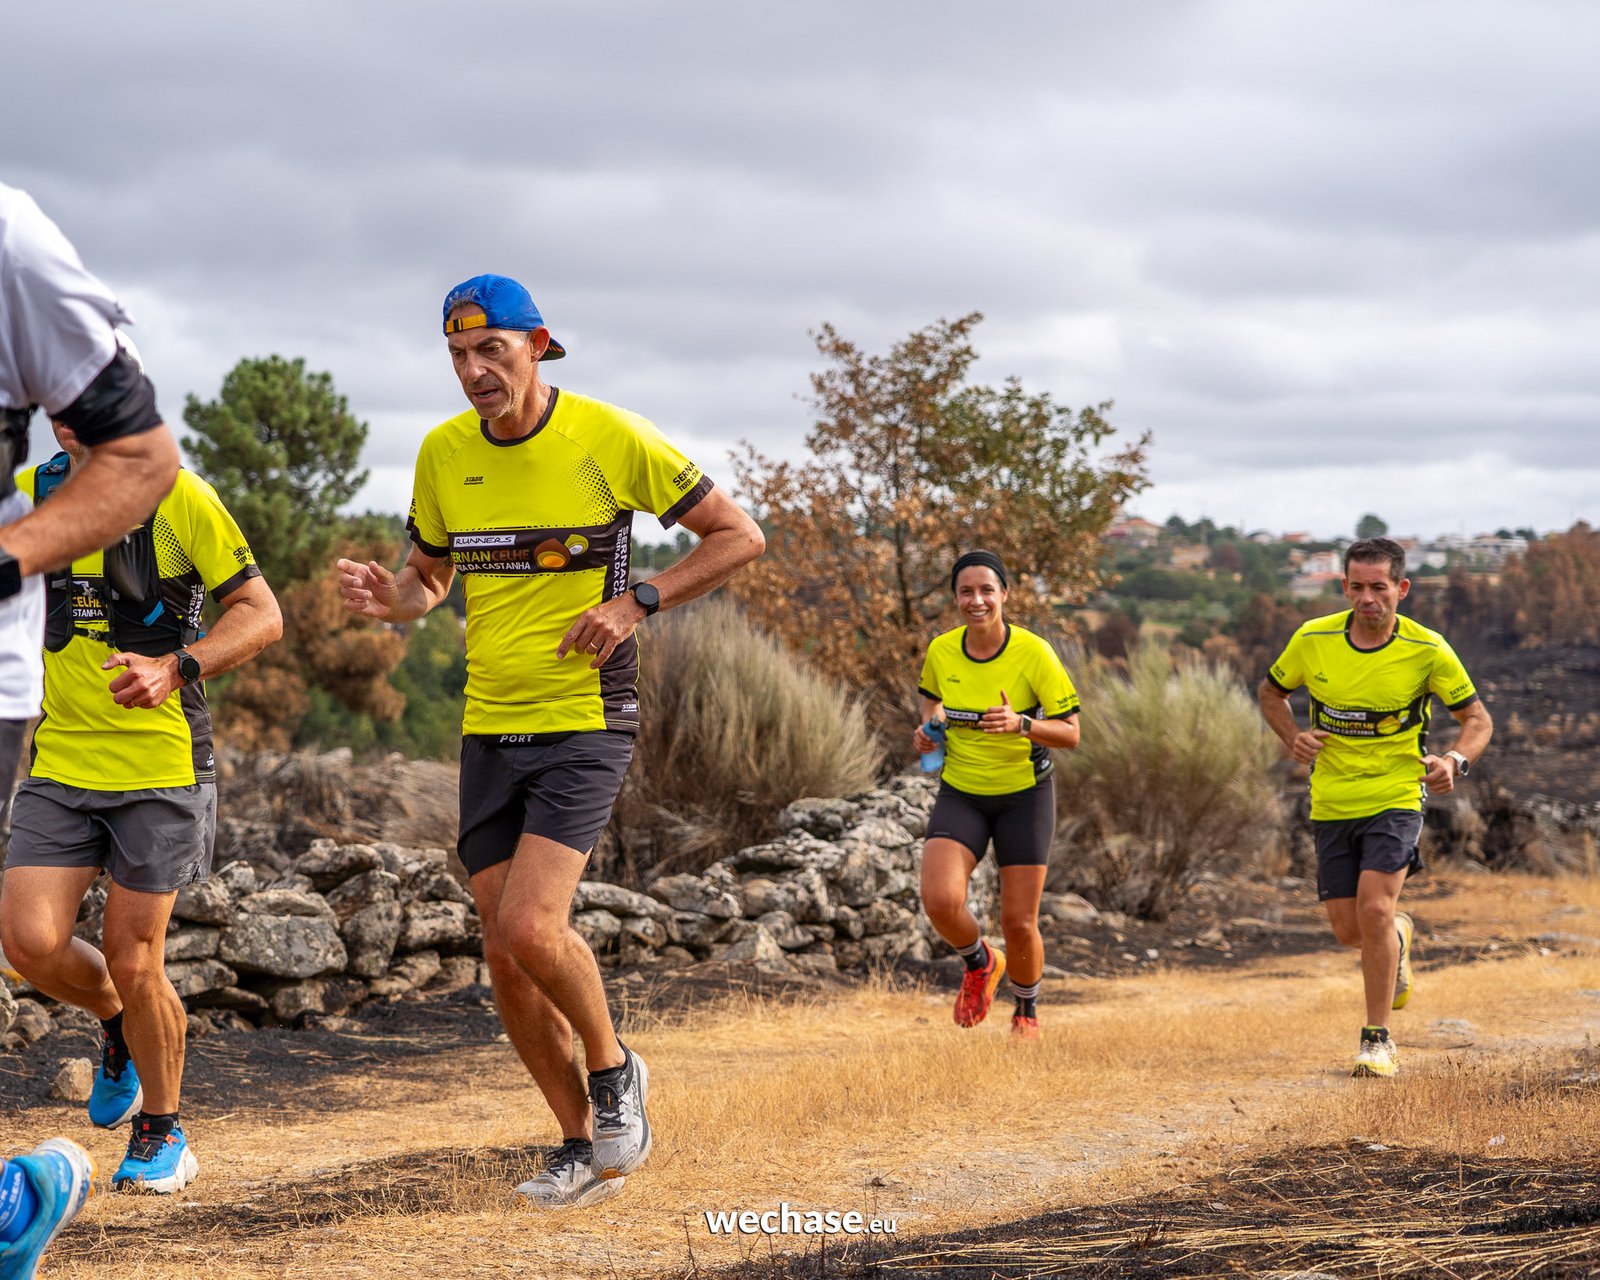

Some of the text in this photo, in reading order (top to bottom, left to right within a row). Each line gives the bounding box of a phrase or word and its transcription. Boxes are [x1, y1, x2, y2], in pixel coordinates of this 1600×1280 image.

[455, 536, 512, 545] RUNNERS
[482, 561, 531, 570] CASTANHA
[500, 734, 534, 743] PORT
